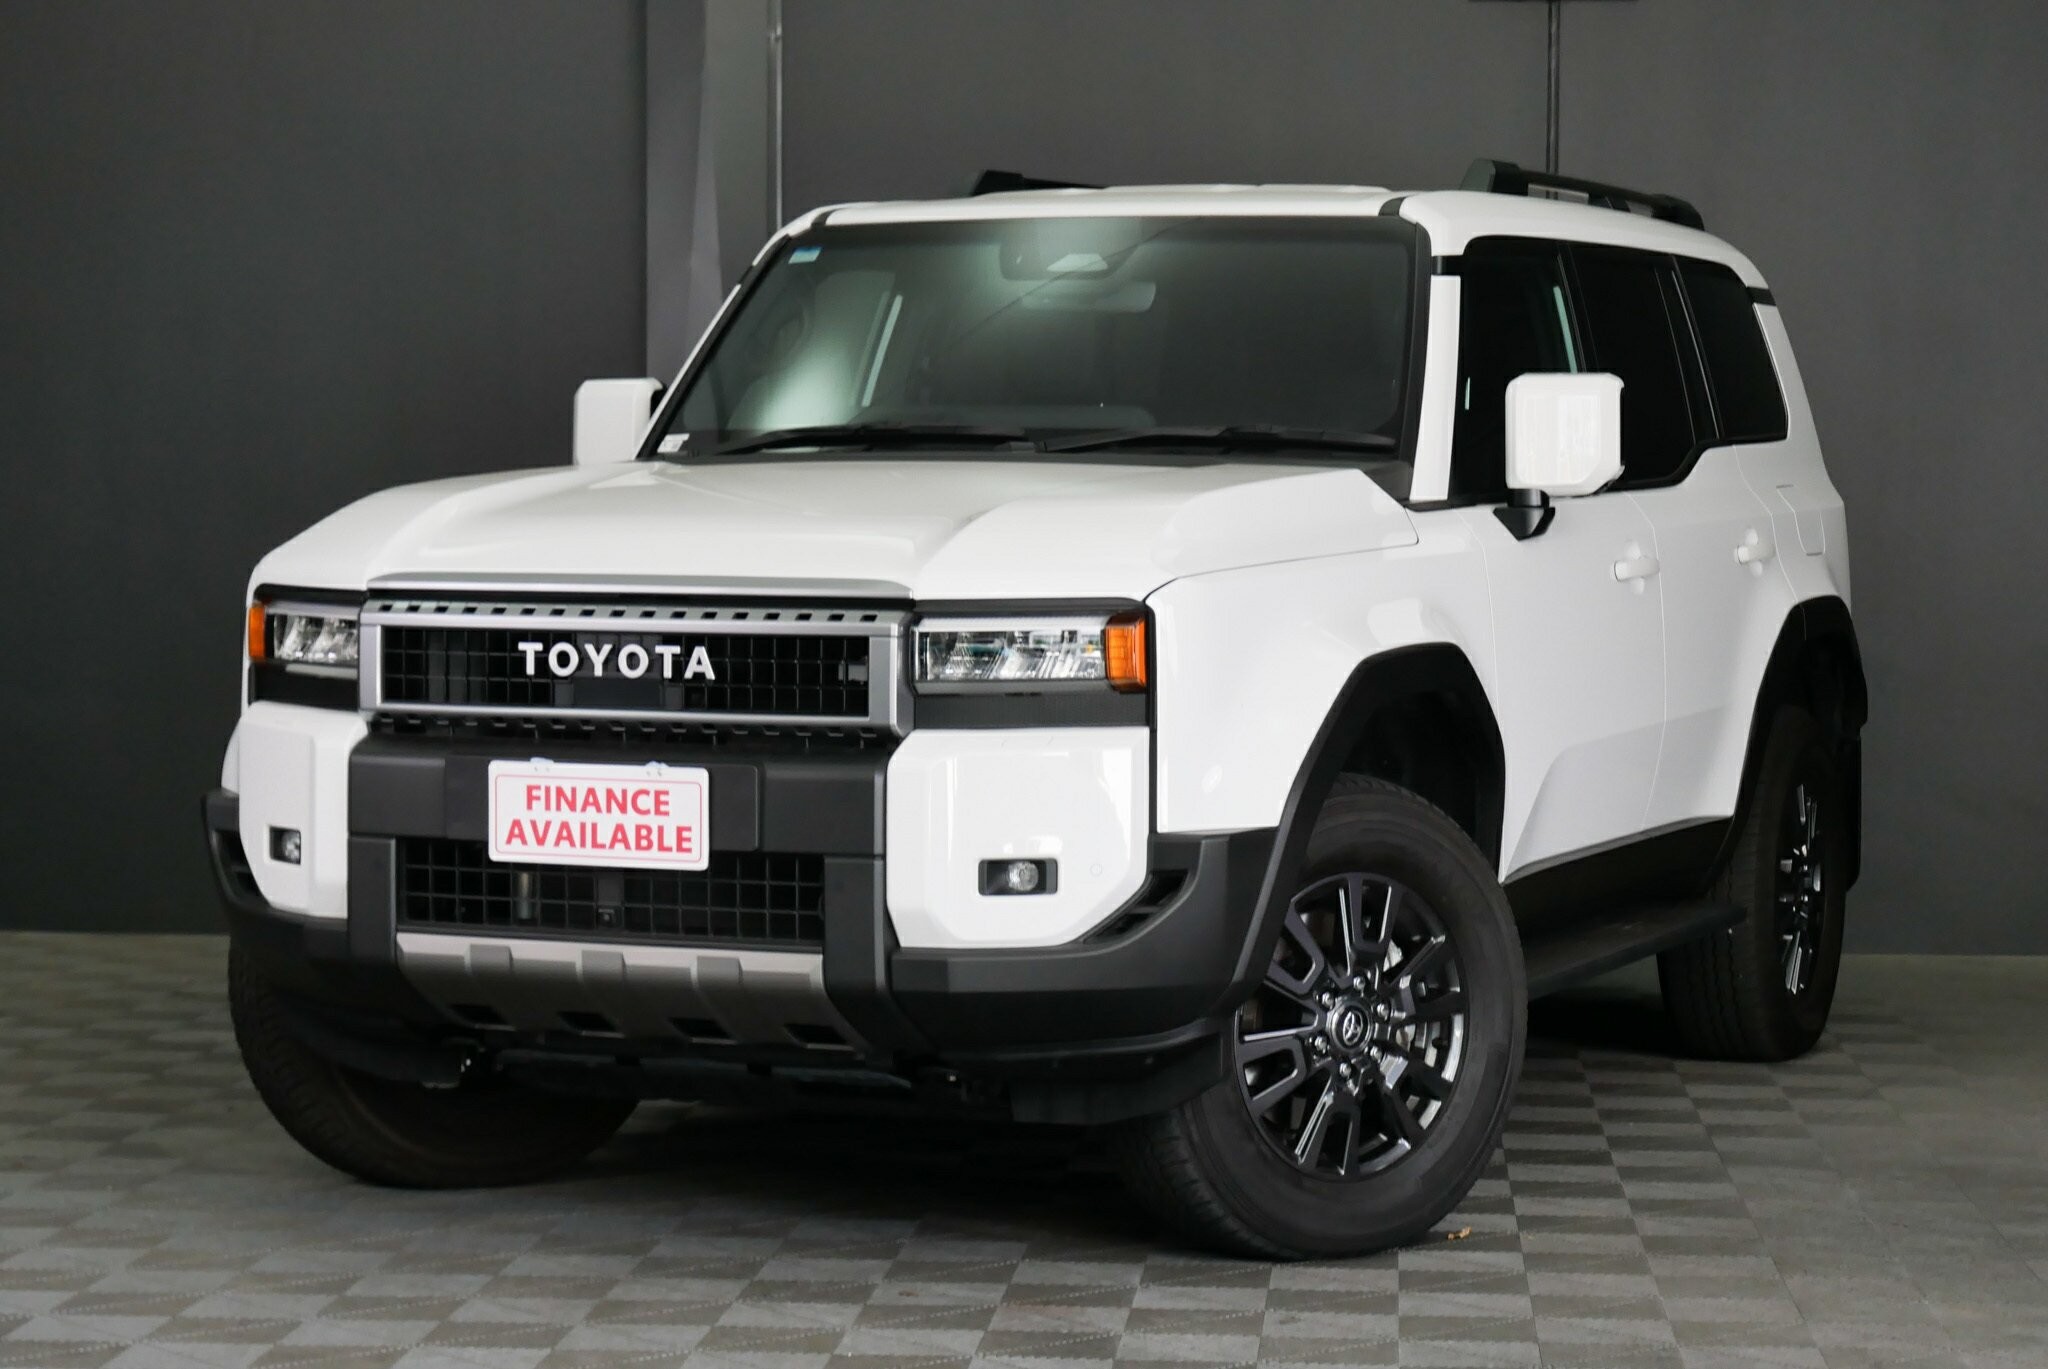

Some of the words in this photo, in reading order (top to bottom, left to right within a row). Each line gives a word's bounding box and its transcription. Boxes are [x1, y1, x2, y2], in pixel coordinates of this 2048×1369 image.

[518, 641, 716, 681] TOYOTA
[526, 784, 670, 817] FINANCE
[505, 818, 693, 853] AVAILABLE
